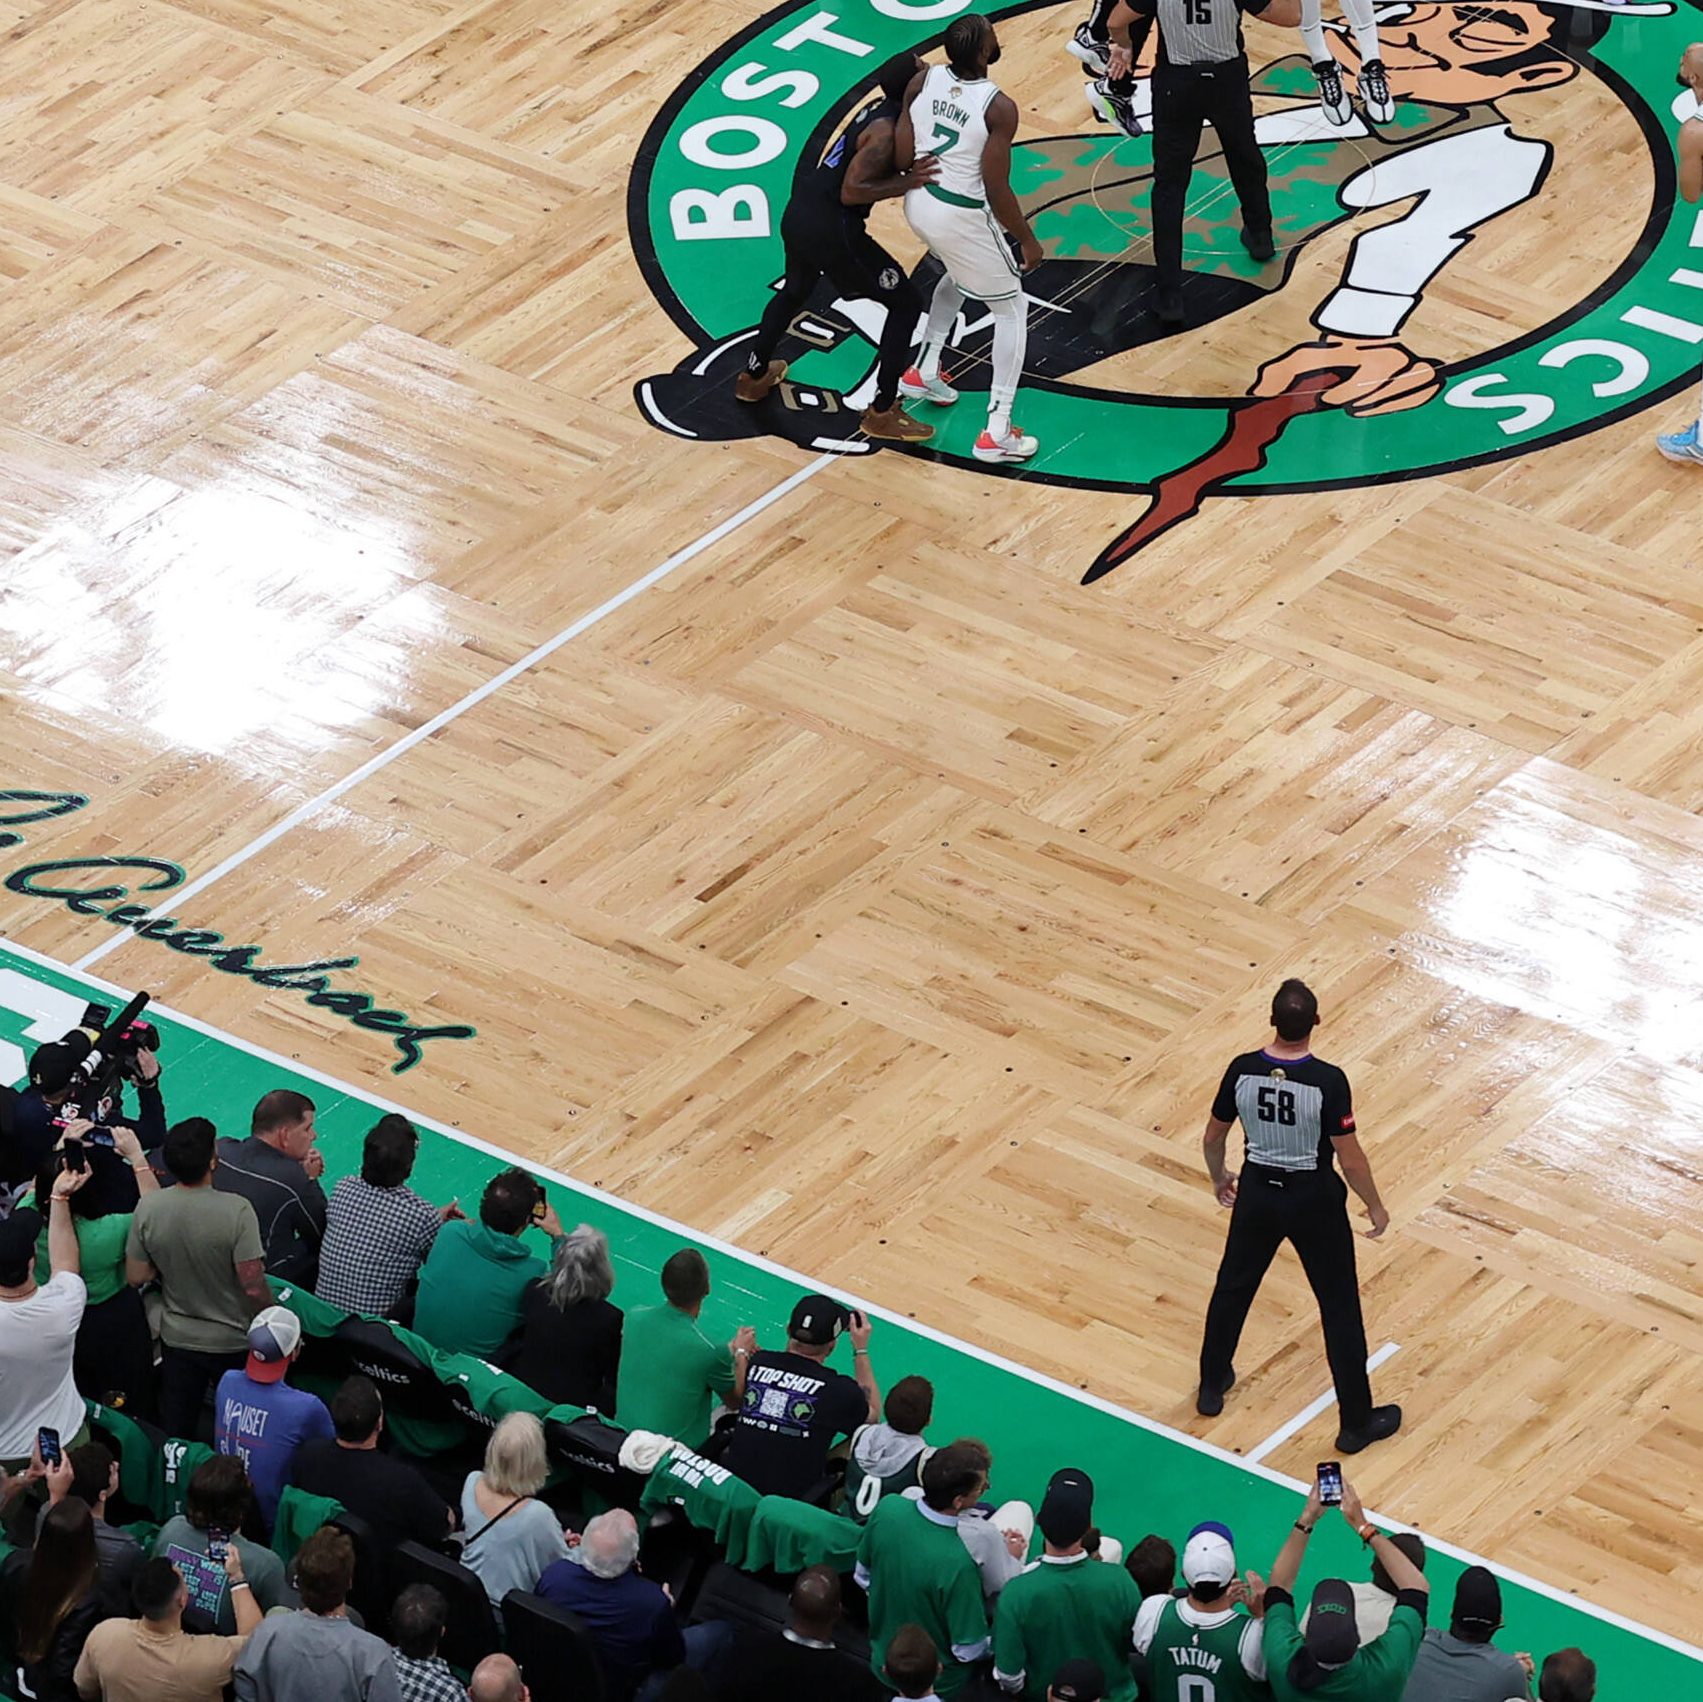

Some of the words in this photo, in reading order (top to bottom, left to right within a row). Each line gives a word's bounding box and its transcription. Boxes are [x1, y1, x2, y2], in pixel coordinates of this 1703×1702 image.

[932, 99, 971, 129] BROWN
[930, 122, 961, 158] 7
[1258, 1087, 1298, 1127] 58
[753, 1365, 785, 1388] TOP
[778, 1370, 826, 1396] SHOT
[225, 1397, 270, 1438] NAUSET
[855, 1474, 881, 1517] 0
[1168, 1646, 1223, 1676] TATUM
